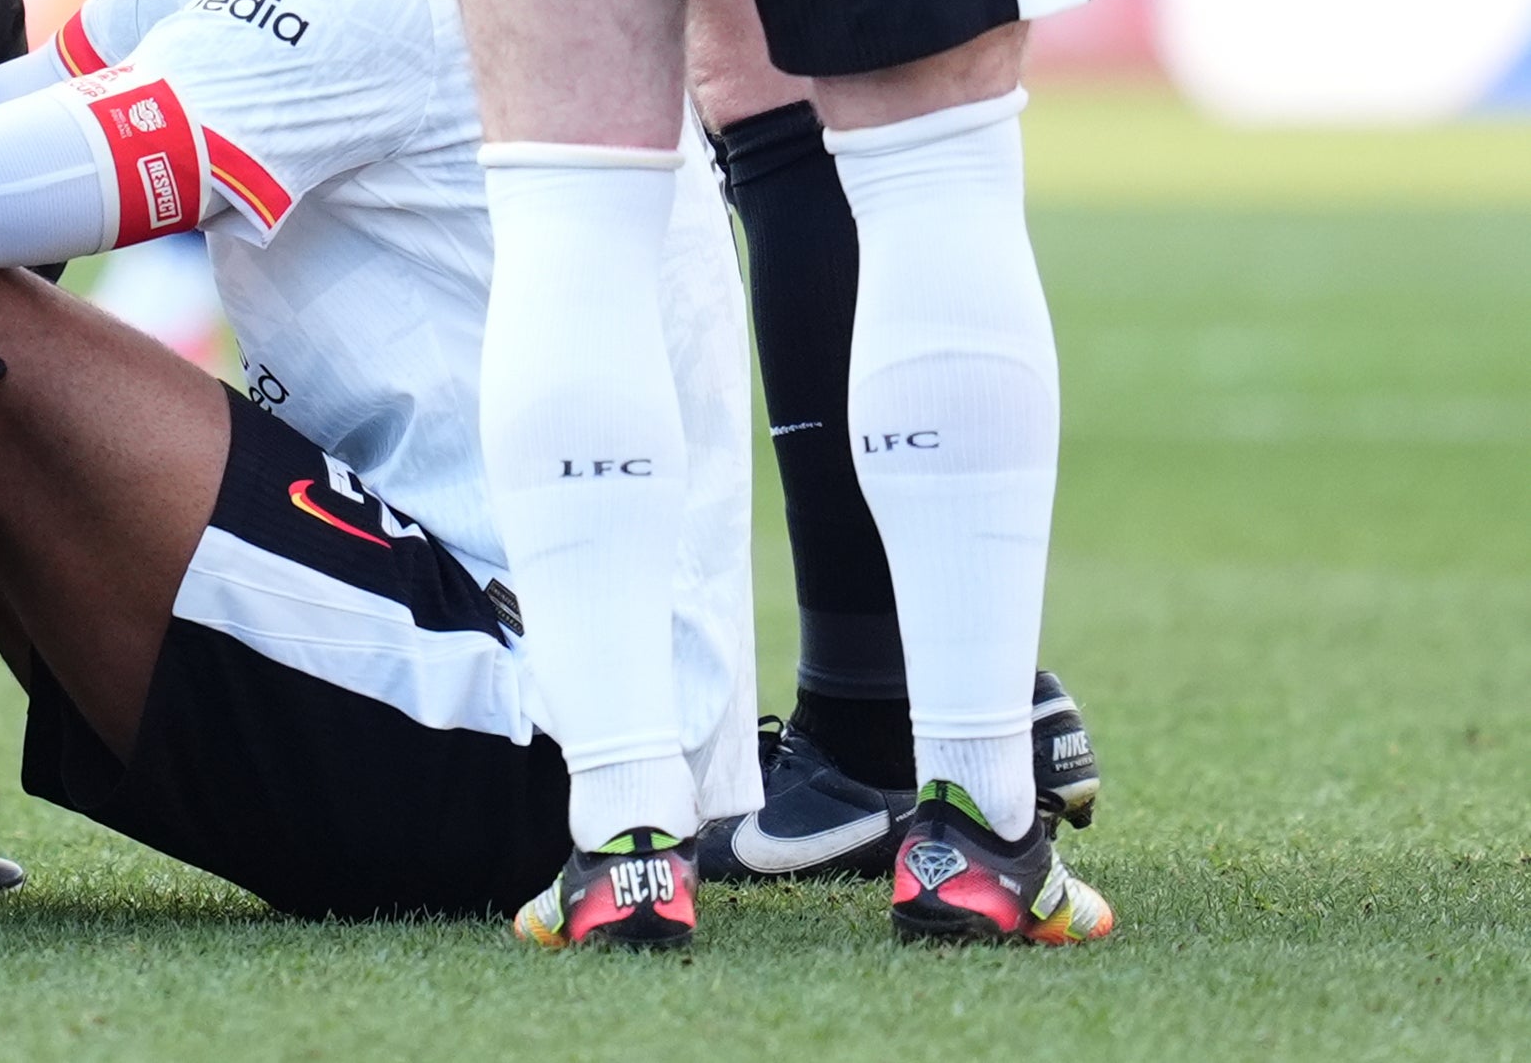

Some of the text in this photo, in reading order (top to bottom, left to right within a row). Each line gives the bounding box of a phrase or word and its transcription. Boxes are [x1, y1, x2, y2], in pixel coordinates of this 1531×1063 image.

[147, 159, 177, 220] RESPECT
[864, 430, 941, 455] LFC
[561, 459, 653, 478] LFC
[1052, 730, 1090, 762] NIKE
